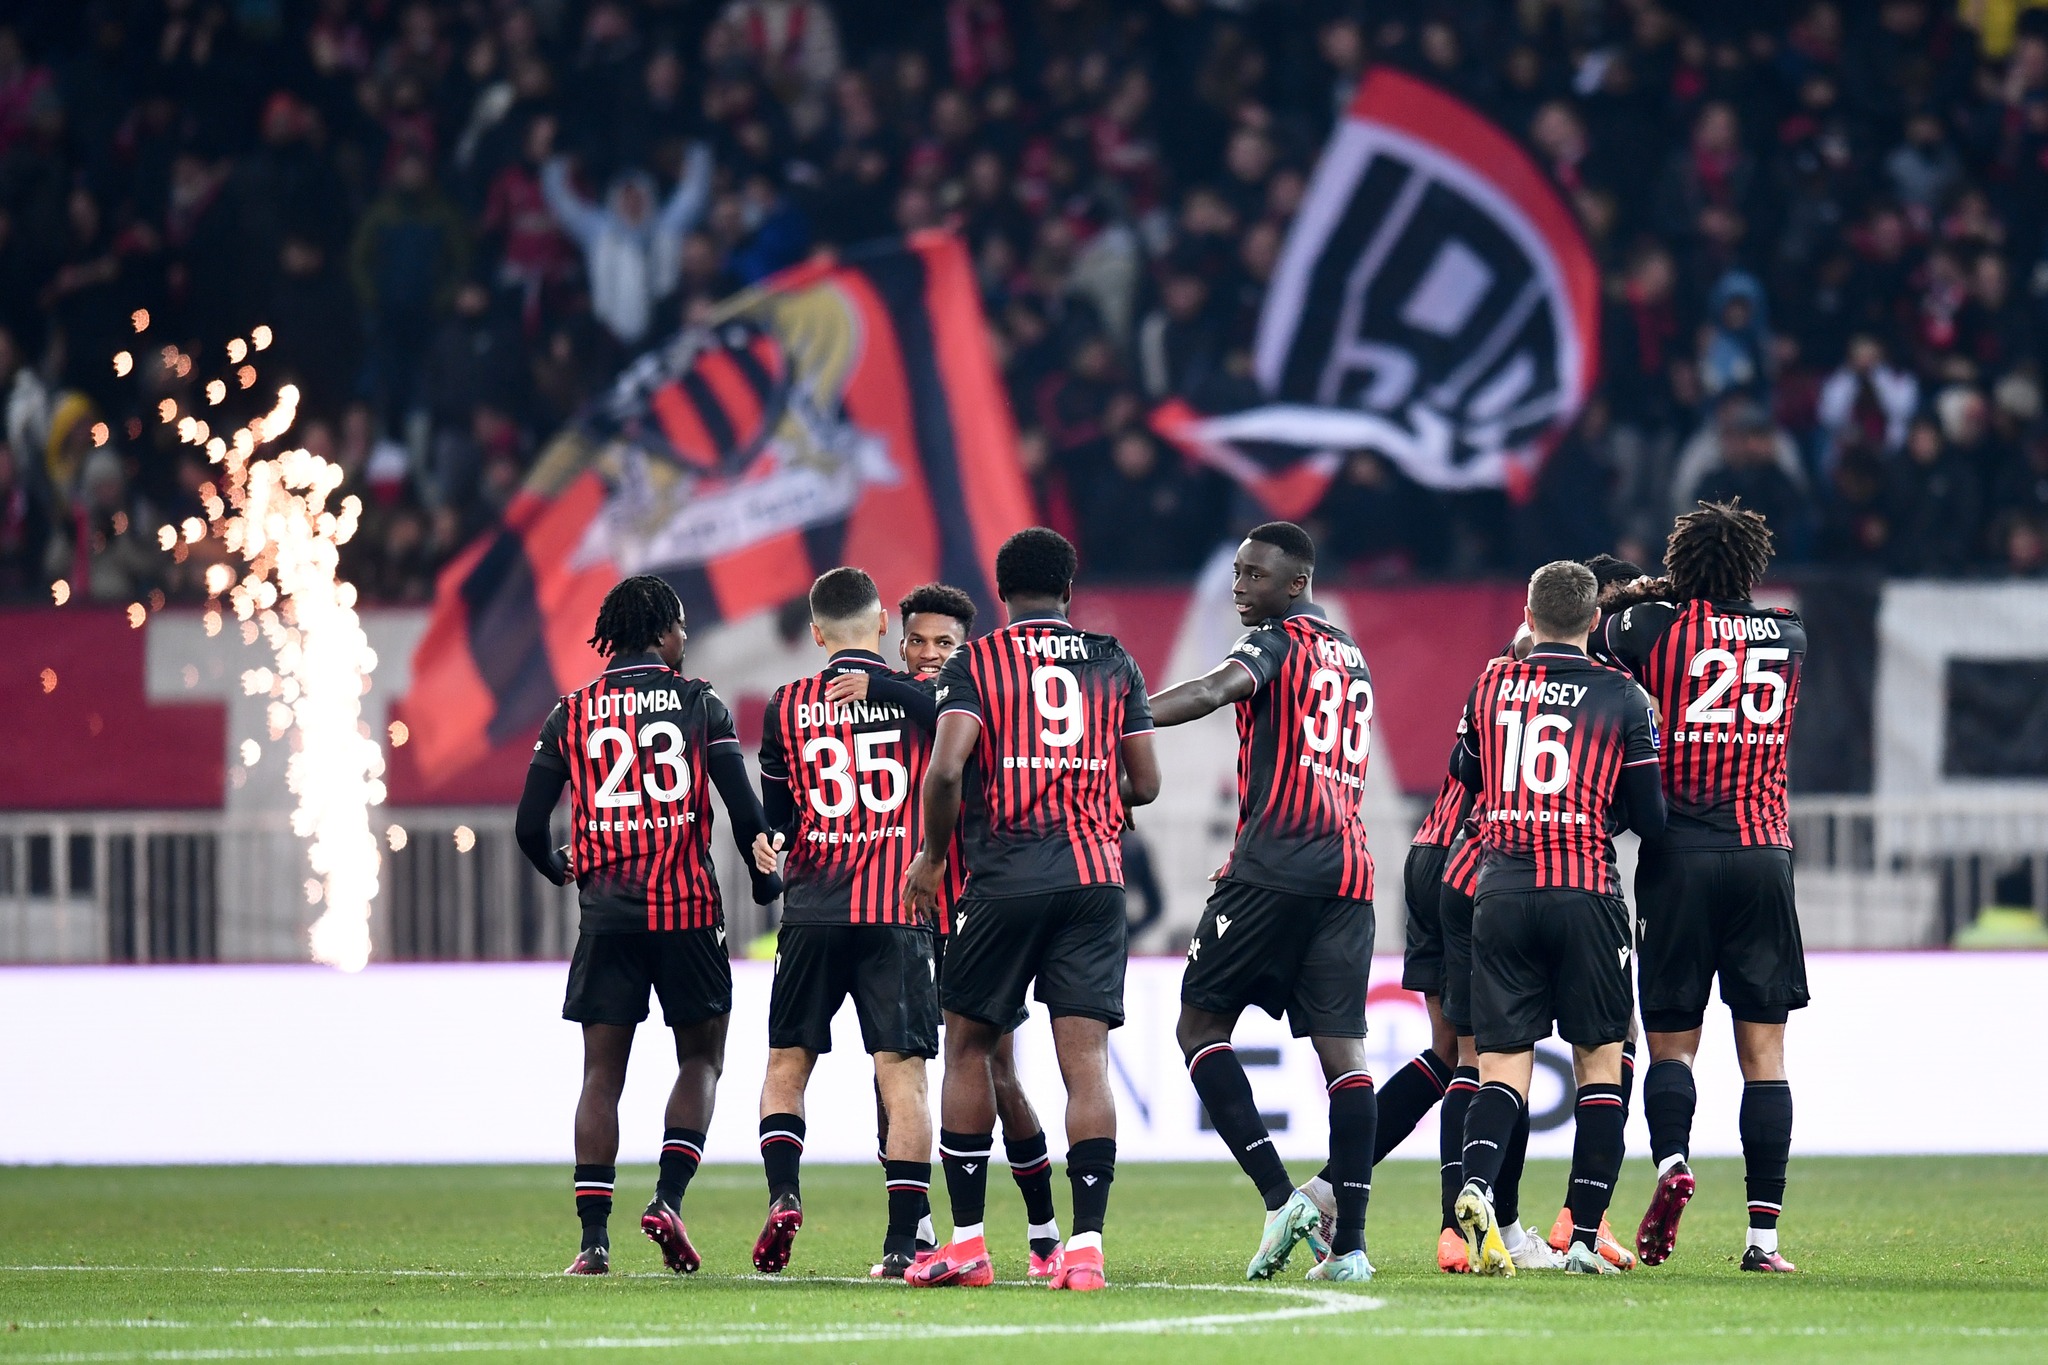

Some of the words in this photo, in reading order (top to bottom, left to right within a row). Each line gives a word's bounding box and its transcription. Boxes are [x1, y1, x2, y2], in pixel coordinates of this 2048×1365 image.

[1707, 616, 1781, 641] TODIBO
[588, 690, 683, 722] LOTOMBA
[1032, 666, 1085, 748] 9
[1497, 678, 1589, 709] RAMSEY
[1685, 647, 1788, 725] 25
[1303, 668, 1374, 765] 33
[1673, 731, 1785, 746] GRENADIER
[586, 720, 692, 808] 23
[803, 730, 909, 819] 35
[1496, 710, 1574, 794] 16
[589, 811, 696, 832] GRENADIER
[807, 826, 907, 844] GRENADIER
